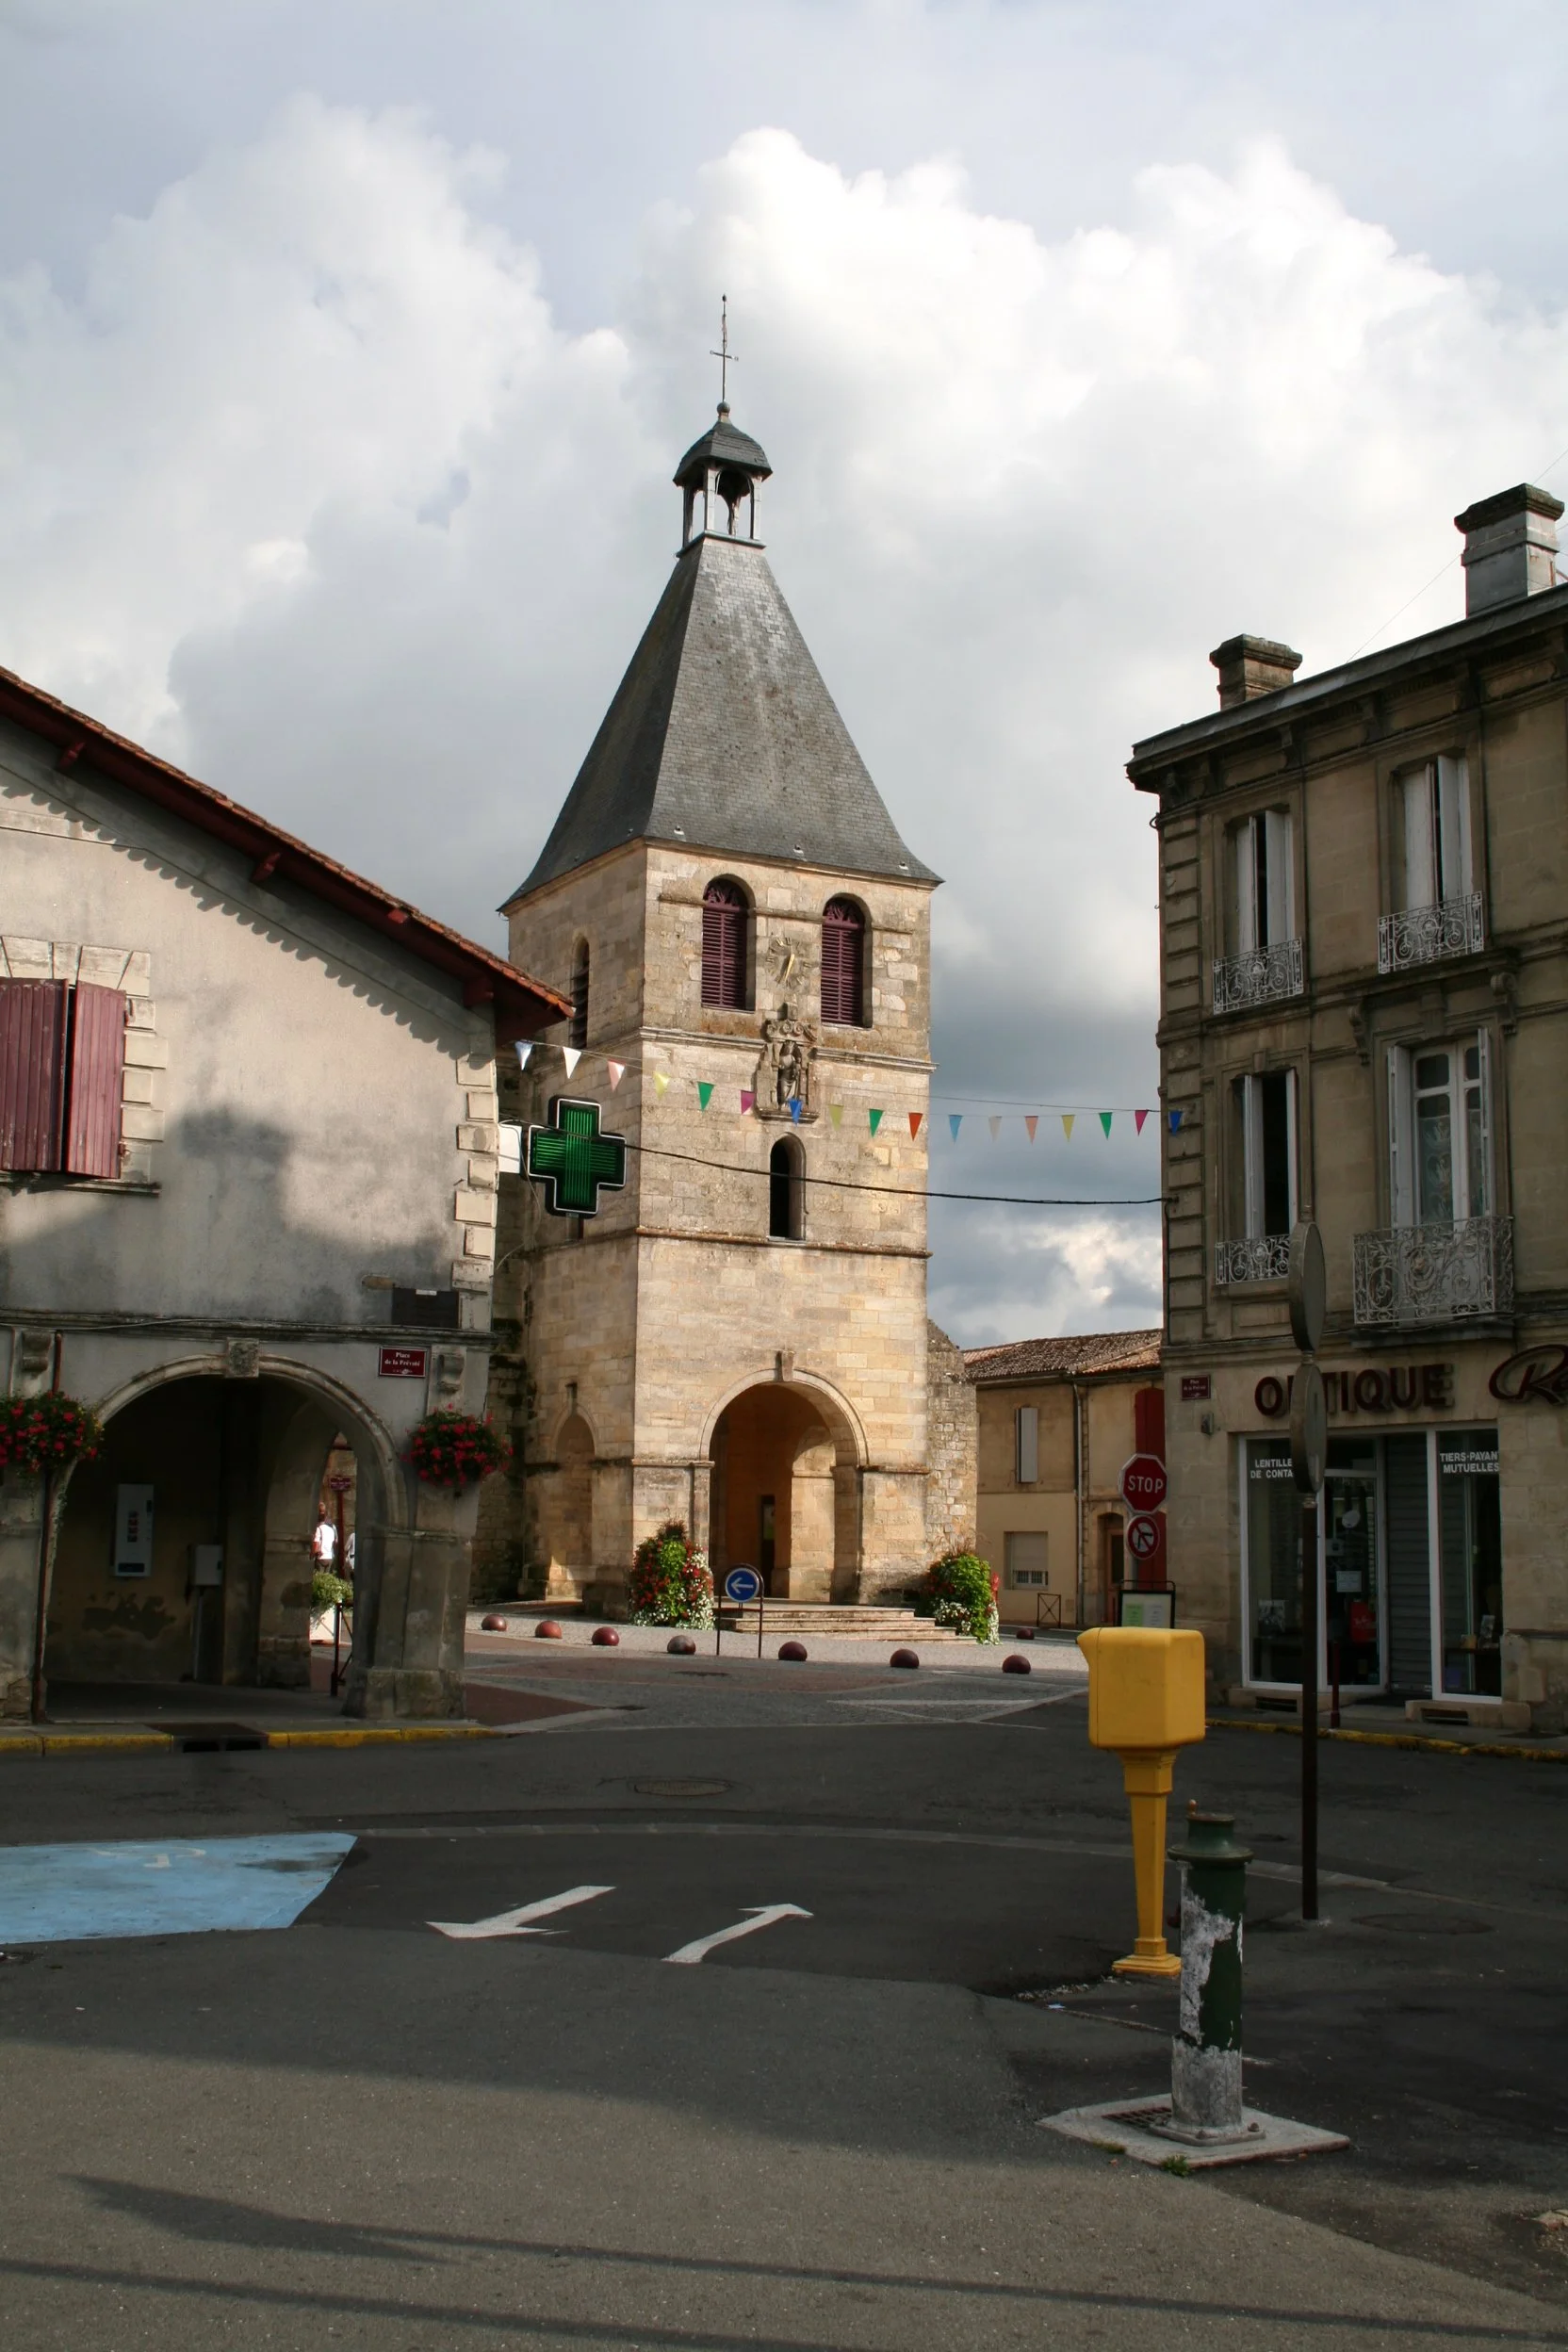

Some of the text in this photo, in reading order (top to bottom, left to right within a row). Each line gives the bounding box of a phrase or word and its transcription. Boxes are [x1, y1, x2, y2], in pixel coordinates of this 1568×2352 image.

[1254, 1364, 1451, 1415] OTIQUE
[1440, 1451, 1499, 1462] TIERS-PAYAN
[1443, 1462, 1500, 1473] MUTUELLES
[1250, 1470, 1262, 1478] DE
[1127, 1474, 1164, 1494] STOP
